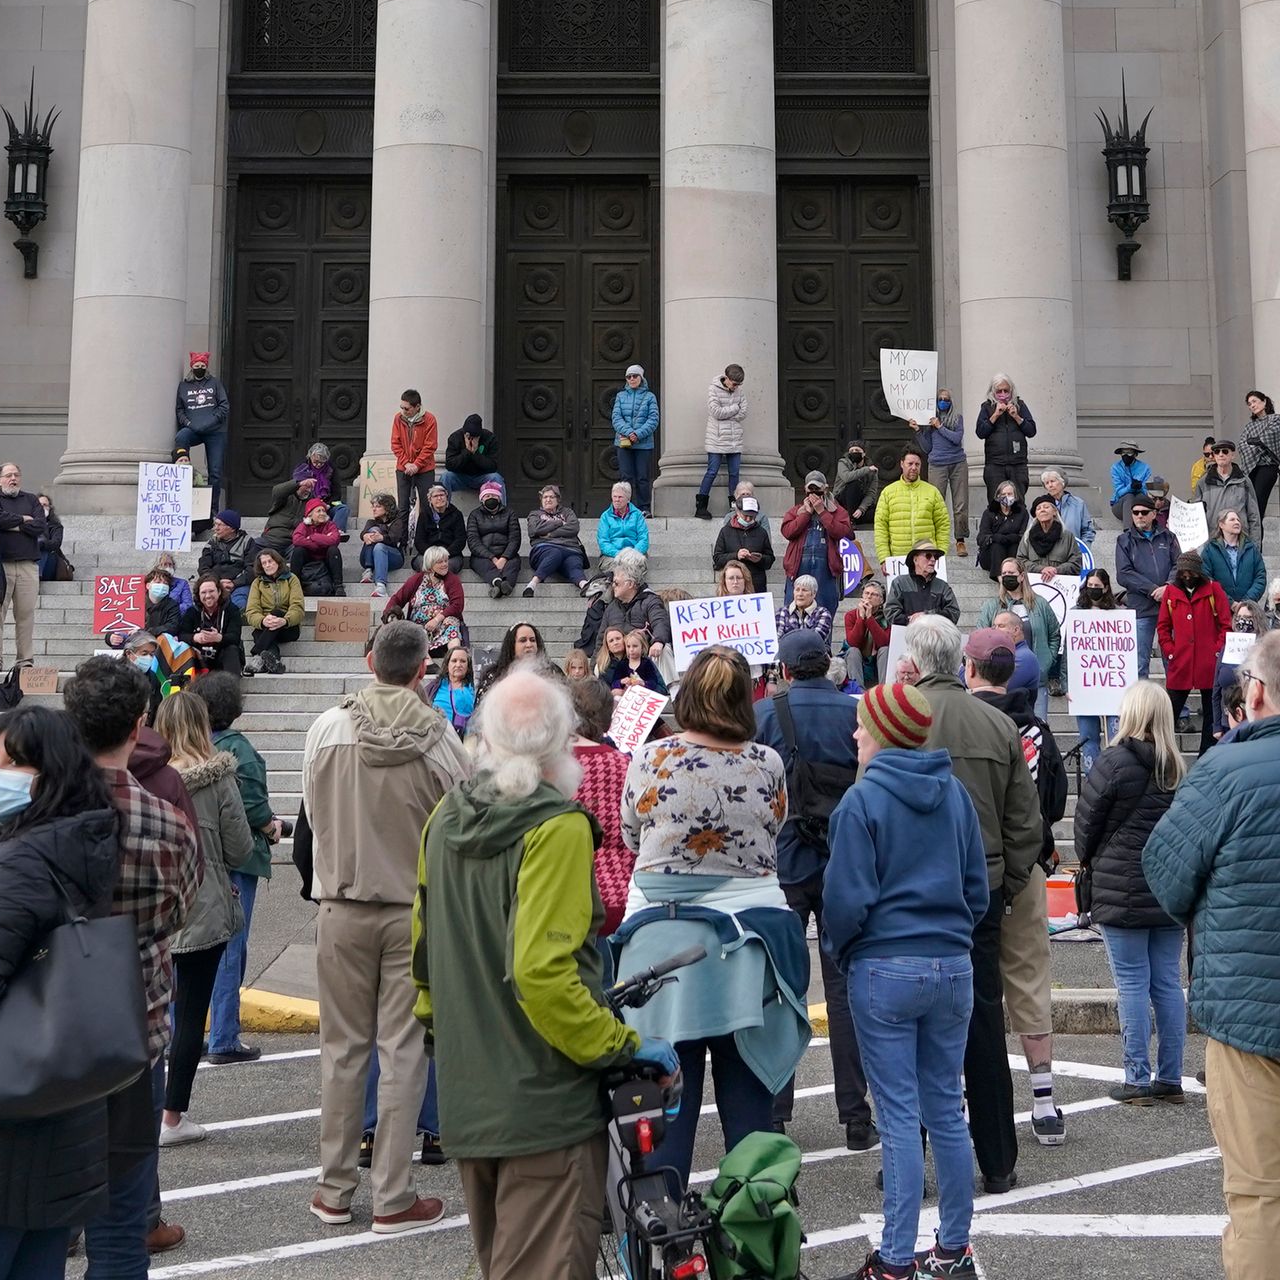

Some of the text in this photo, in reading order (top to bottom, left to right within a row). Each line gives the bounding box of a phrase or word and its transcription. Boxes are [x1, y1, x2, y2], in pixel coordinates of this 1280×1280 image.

[890, 351, 910, 365] MY
[900, 368, 928, 382] BODY
[890, 383, 909, 396] MY
[897, 398, 935, 411] CHOICE
[367, 461, 396, 483] KEE
[147, 479, 181, 492] BELIEVE
[141, 492, 153, 503] WE
[155, 492, 180, 503] STILL
[147, 503, 181, 514] HAVE TO
[150, 514, 190, 527] PROTEST
[150, 527, 172, 537] THIS
[141, 531, 186, 551] SHIT!
[98, 577, 141, 595] SALE
[676, 596, 765, 624] RESPECT
[681, 621, 760, 643] MY RIGHT
[1073, 619, 1132, 634] PLANNED
[730, 639, 775, 656] OOSE
[1071, 636, 1135, 652] PARENTHOOD
[1081, 654, 1126, 670] SAVES
[1083, 671, 1126, 687] LIVES
[625, 697, 664, 751] ABORTION
